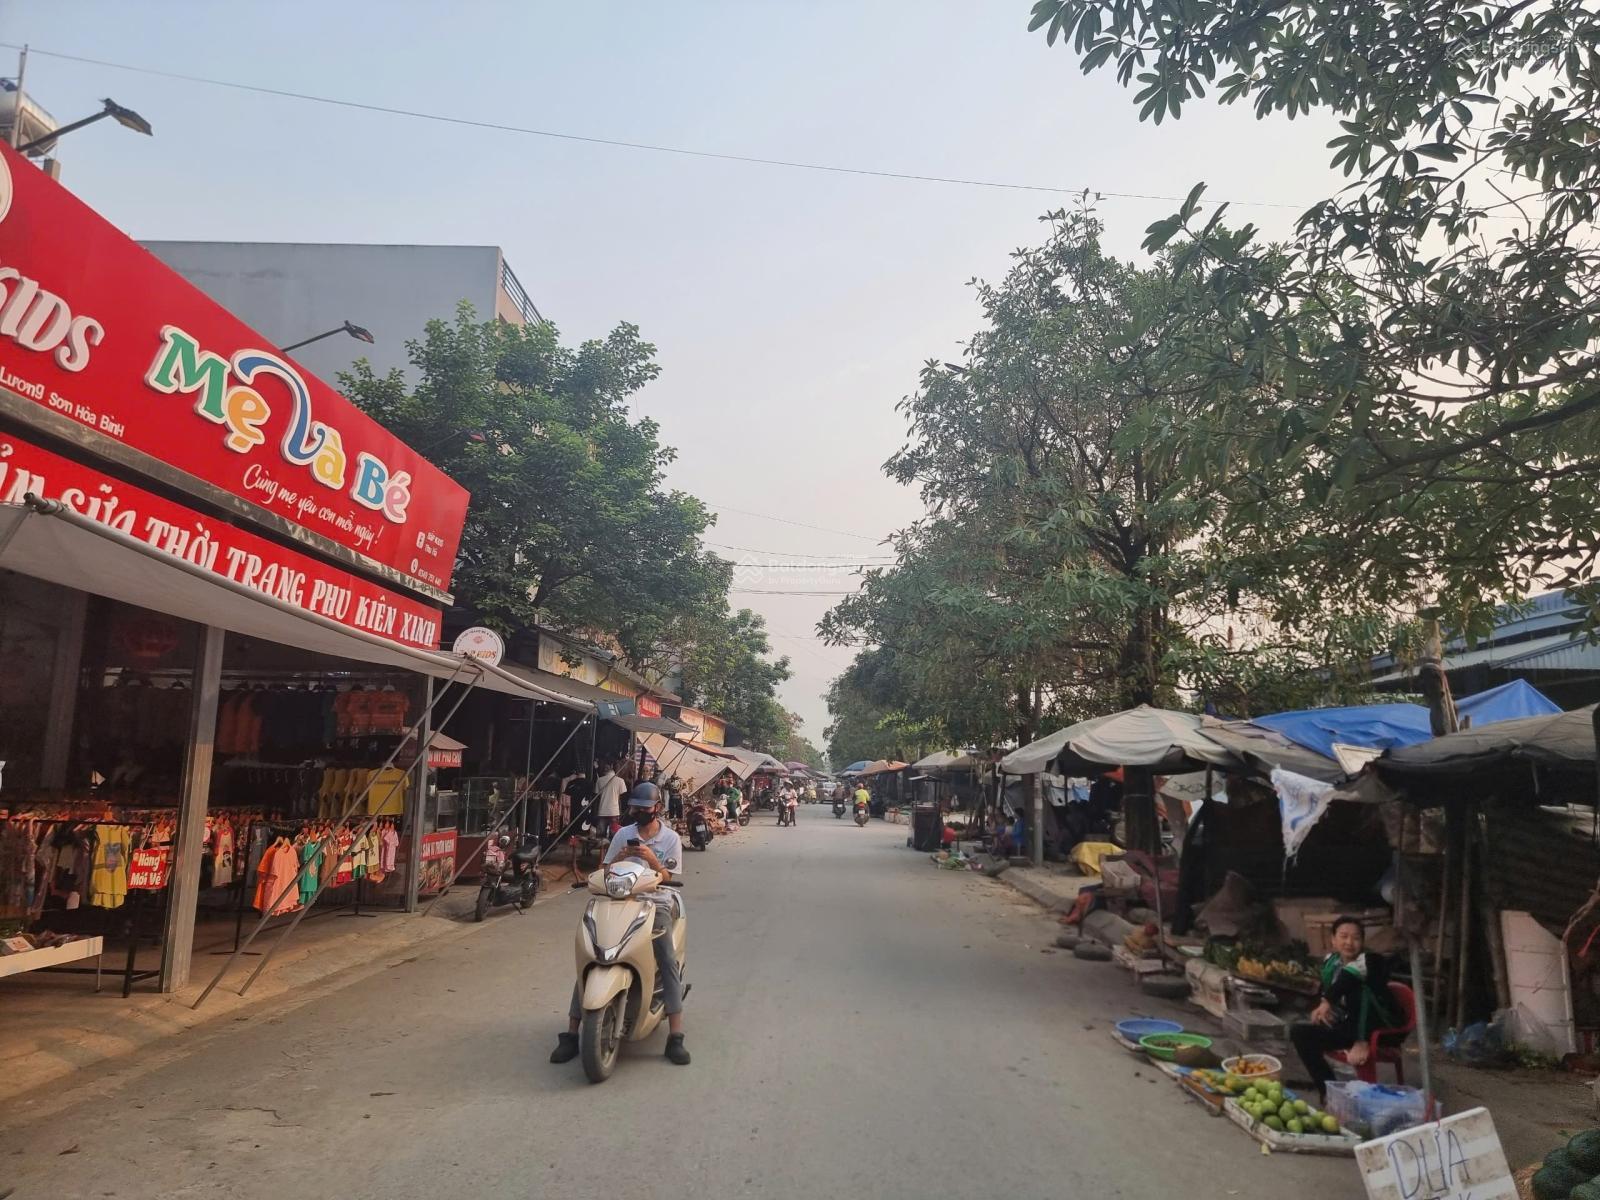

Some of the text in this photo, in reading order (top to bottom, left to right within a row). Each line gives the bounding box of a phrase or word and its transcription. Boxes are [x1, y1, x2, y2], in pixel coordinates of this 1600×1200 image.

[0, 366, 45, 399] Lương
[48, 392, 74, 414] Sơn
[75, 404, 96, 425] Hòa
[145, 325, 271, 453] Mẹ
[350, 451, 411, 523] Bé
[243, 463, 279, 504] Cùng
[277, 486, 298, 509] mẹ
[299, 495, 318, 520] yêu
[144, 516, 220, 572] THỜI
[227, 546, 306, 606] TRANG
[399, 611, 436, 647] XINH
